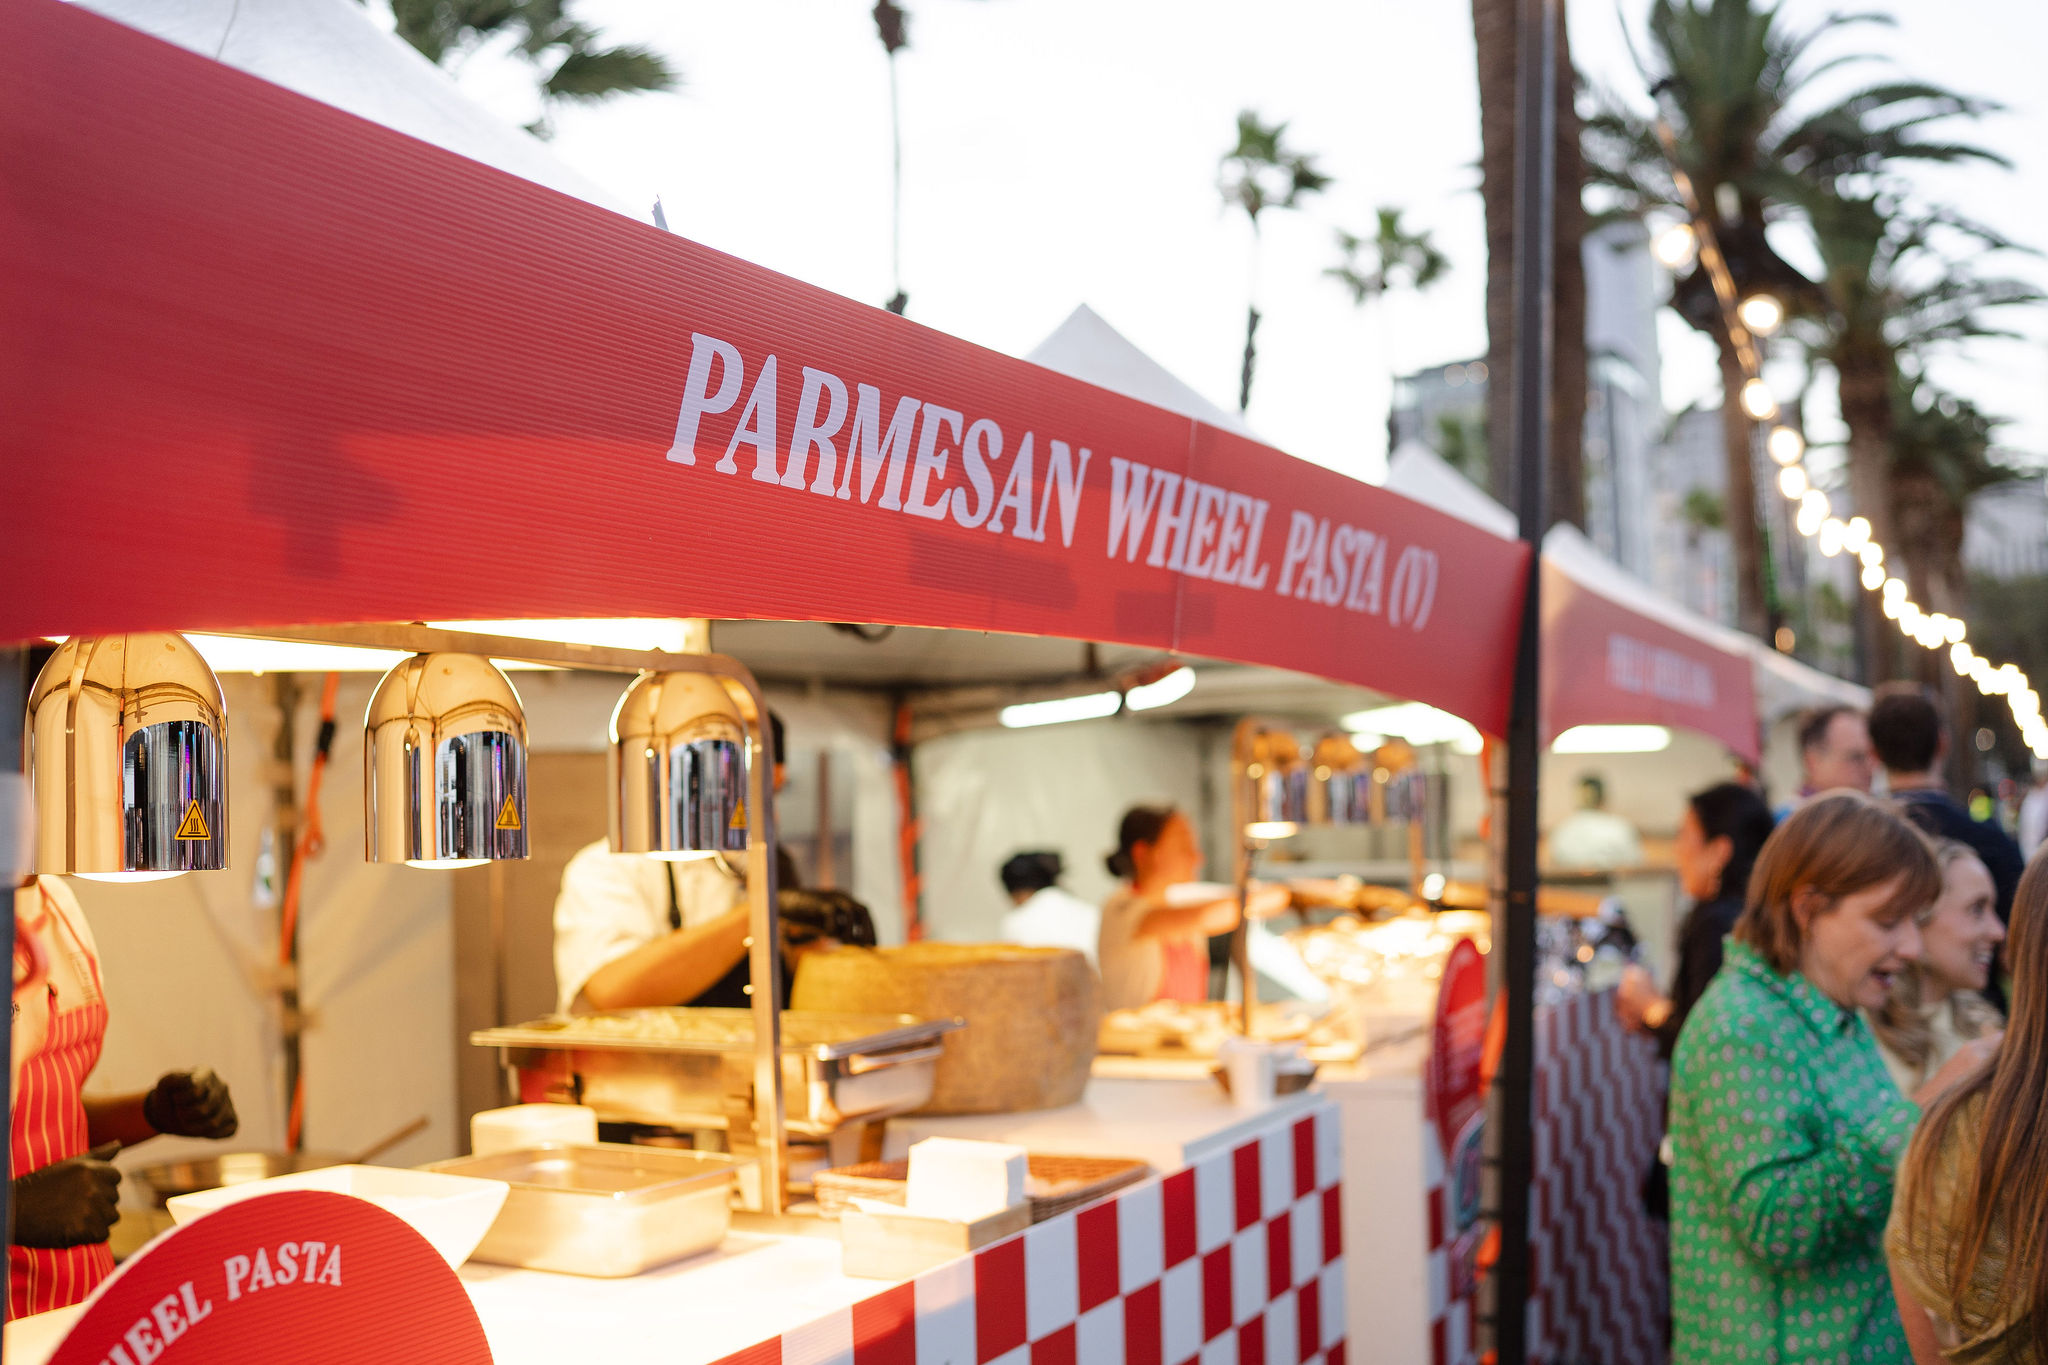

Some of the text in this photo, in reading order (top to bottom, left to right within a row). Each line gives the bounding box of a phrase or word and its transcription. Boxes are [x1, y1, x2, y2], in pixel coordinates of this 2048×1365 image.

[667, 332, 1091, 548] PARMESAN
[1106, 456, 1269, 589] WHEEL
[1276, 510, 1388, 615] PASTA
[224, 1241, 341, 1301] PASTA
